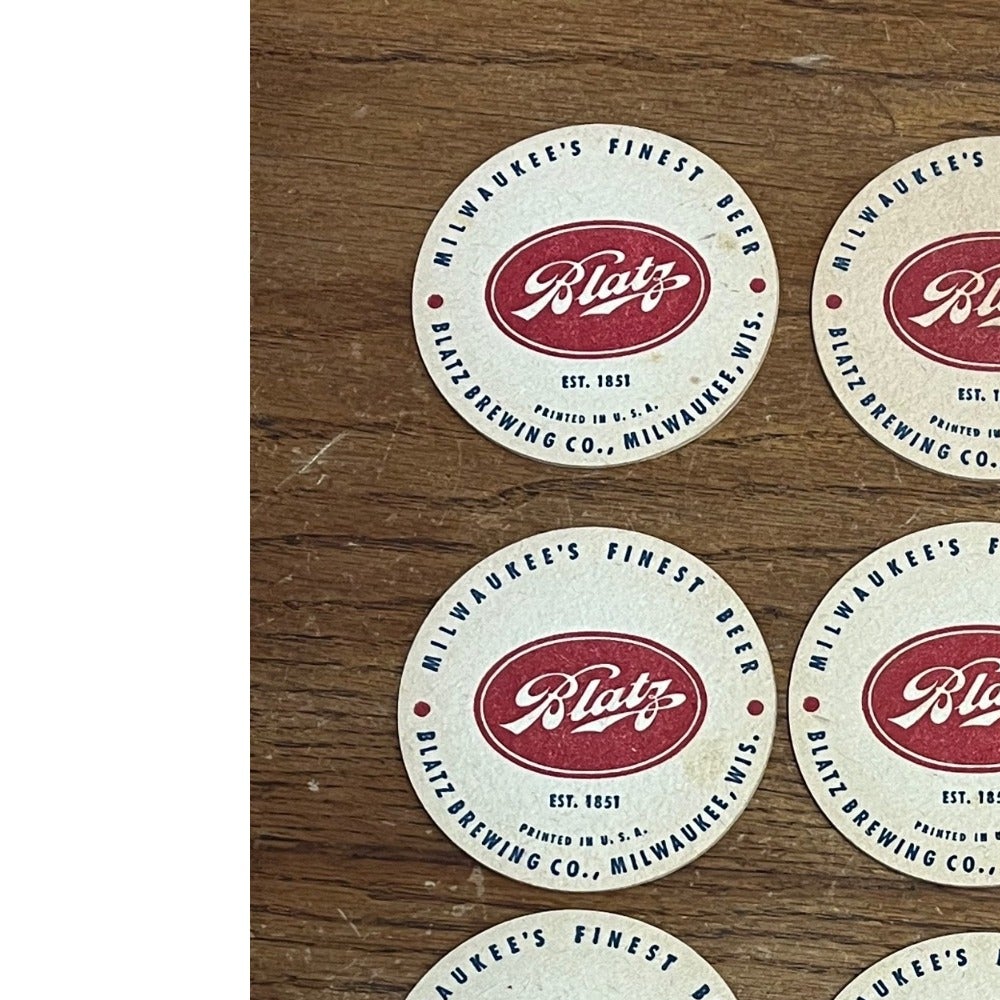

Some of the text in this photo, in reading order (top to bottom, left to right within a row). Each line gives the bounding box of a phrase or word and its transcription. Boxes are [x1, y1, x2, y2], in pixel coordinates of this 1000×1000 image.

[434, 138, 759, 267] MILWAUKEE'S FINEST BEER
[832, 151, 983, 271] MILWAUKEE'S
[511, 250, 690, 320] Blatz
[432, 312, 763, 455] BLATZ BREWING CO., MILWAUKEE, WIS.
[534, 405, 585, 424] PRINTED
[562, 374, 630, 388] EST. 1851
[828, 328, 866, 390] BLATZ
[860, 393, 951, 459] BREWING
[958, 388, 985, 401] EST.
[930, 415, 980, 437] PRINTED
[422, 543, 758, 674] MILWAUKEE'S FINEST BEER
[809, 539, 959, 671] MILWAUKEE'S
[500, 664, 686, 734] Blatz
[417, 731, 759, 880] BLATZ BREWING CO., MILWAUKEE, WIS.
[550, 794, 619, 809] EST. 1851
[807, 731, 847, 797] BLATZ
[842, 799, 936, 866] BREWING
[947, 855, 995, 875] CO.,
[914, 821, 966, 841] PRINTED
[943, 791, 971, 804] EST.
[519, 824, 593, 846] PRINTED IN
[575, 926, 677, 971] FINEST
